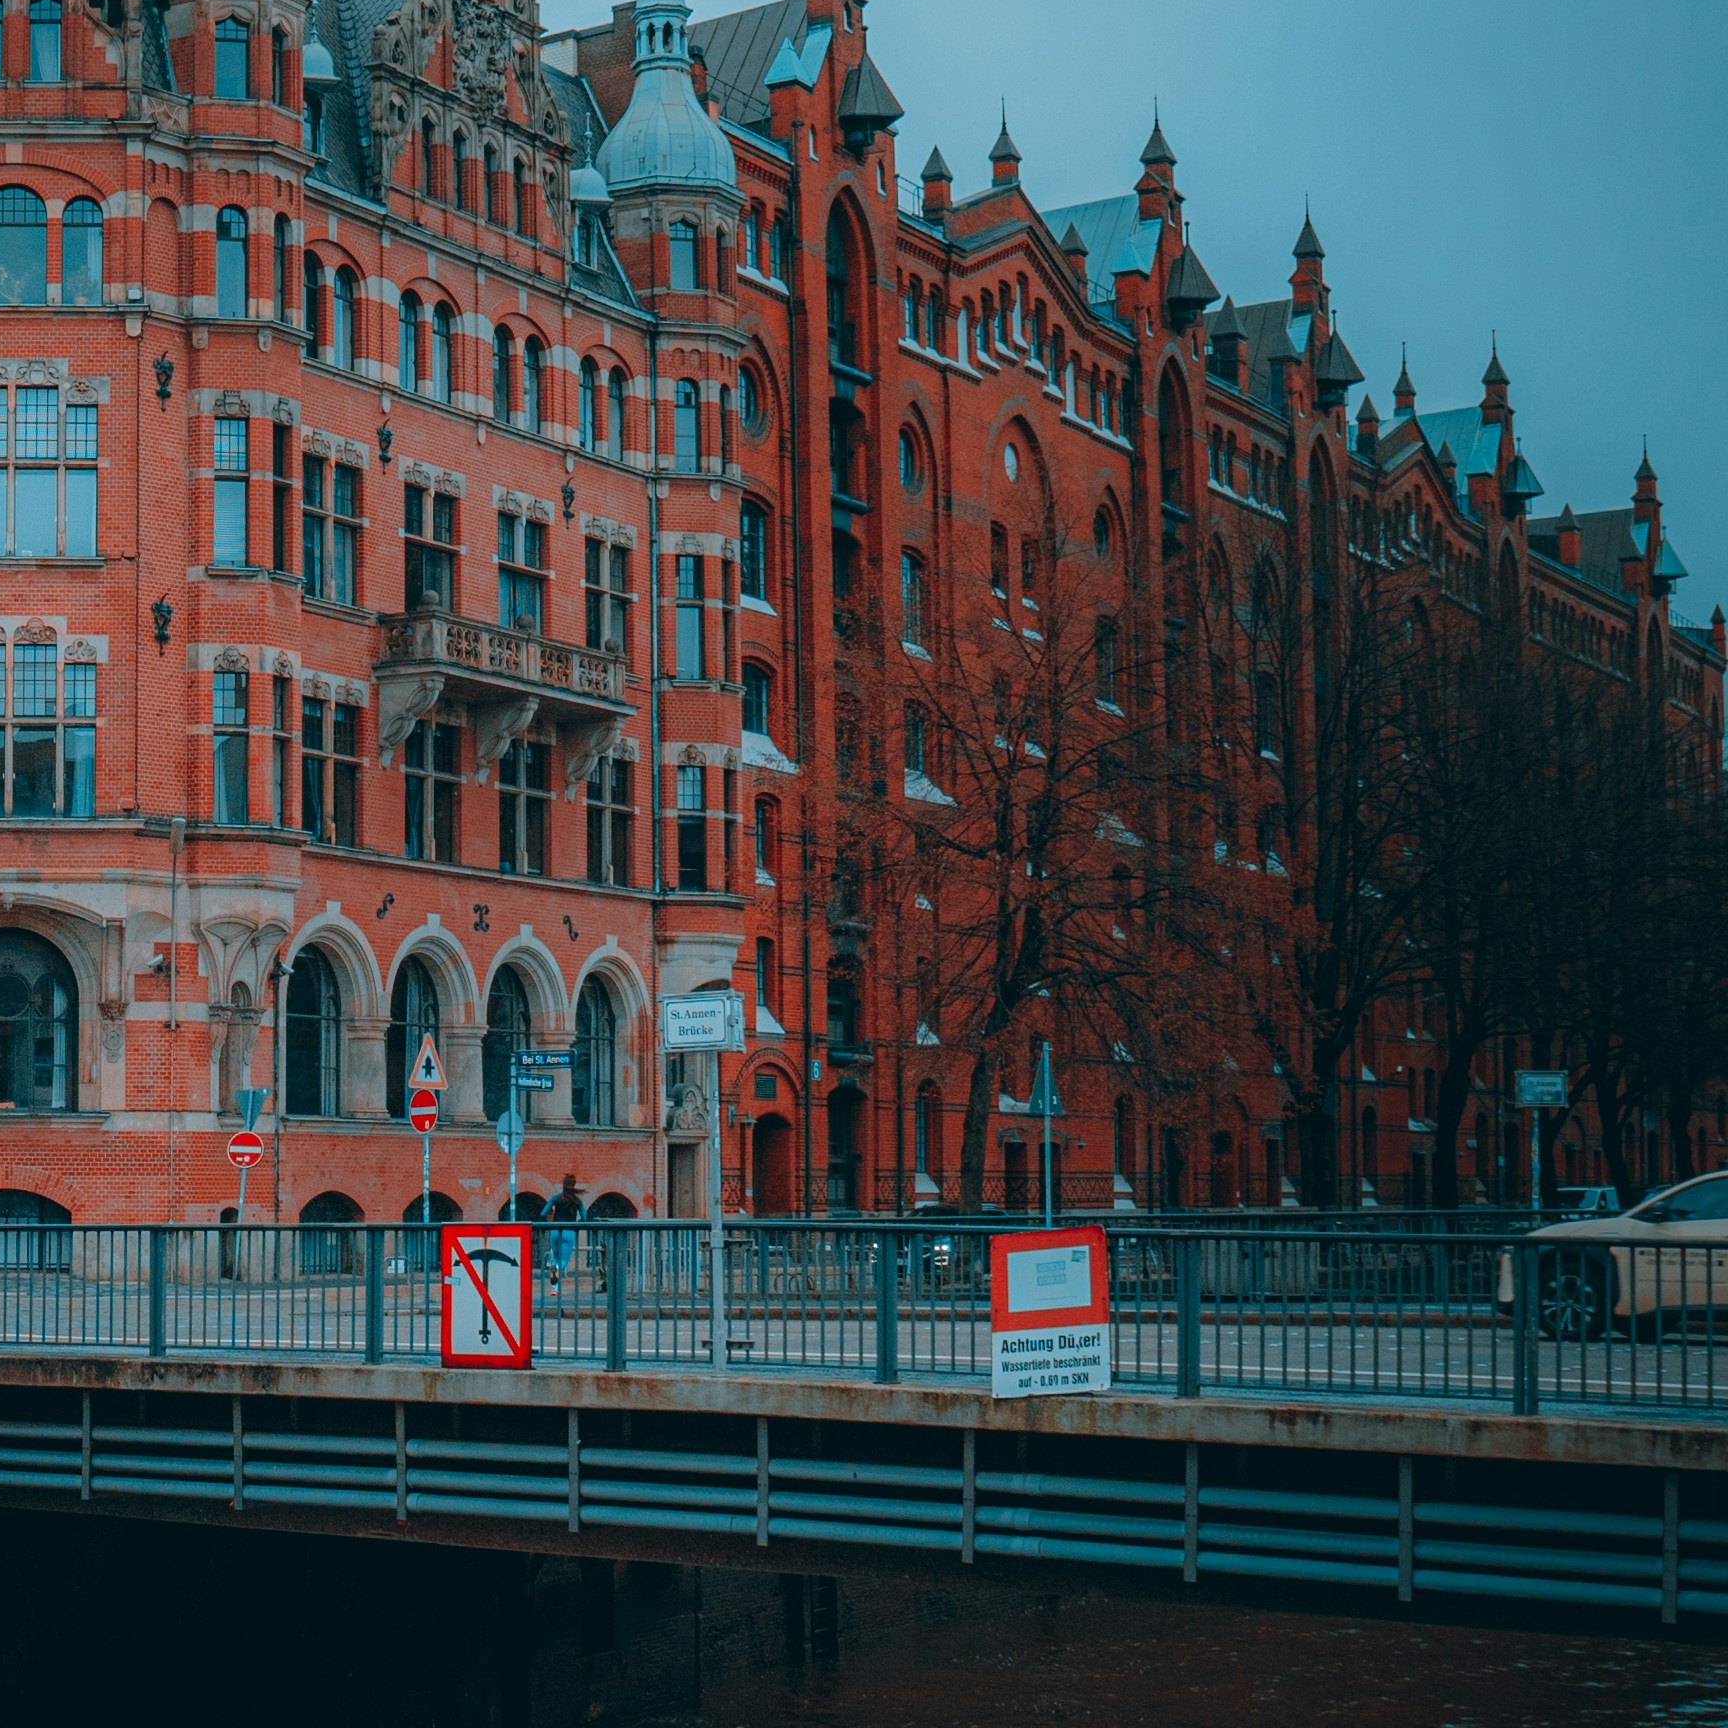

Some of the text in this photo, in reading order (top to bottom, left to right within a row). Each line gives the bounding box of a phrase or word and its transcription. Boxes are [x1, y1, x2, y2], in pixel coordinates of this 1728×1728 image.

[670, 1010, 683, 1020] St.
[678, 1025, 714, 1036] Brücke
[522, 1055, 534, 1065] Bei
[813, 1062, 820, 1078] 6
[1001, 1337, 1054, 1354] Achtung
[1001, 1355, 1101, 1372] Wassertiefe beschränkt
[1018, 1376, 1032, 1388] auf
[1061, 1376, 1069, 1385] m
[1071, 1372, 1089, 1384] SKN
